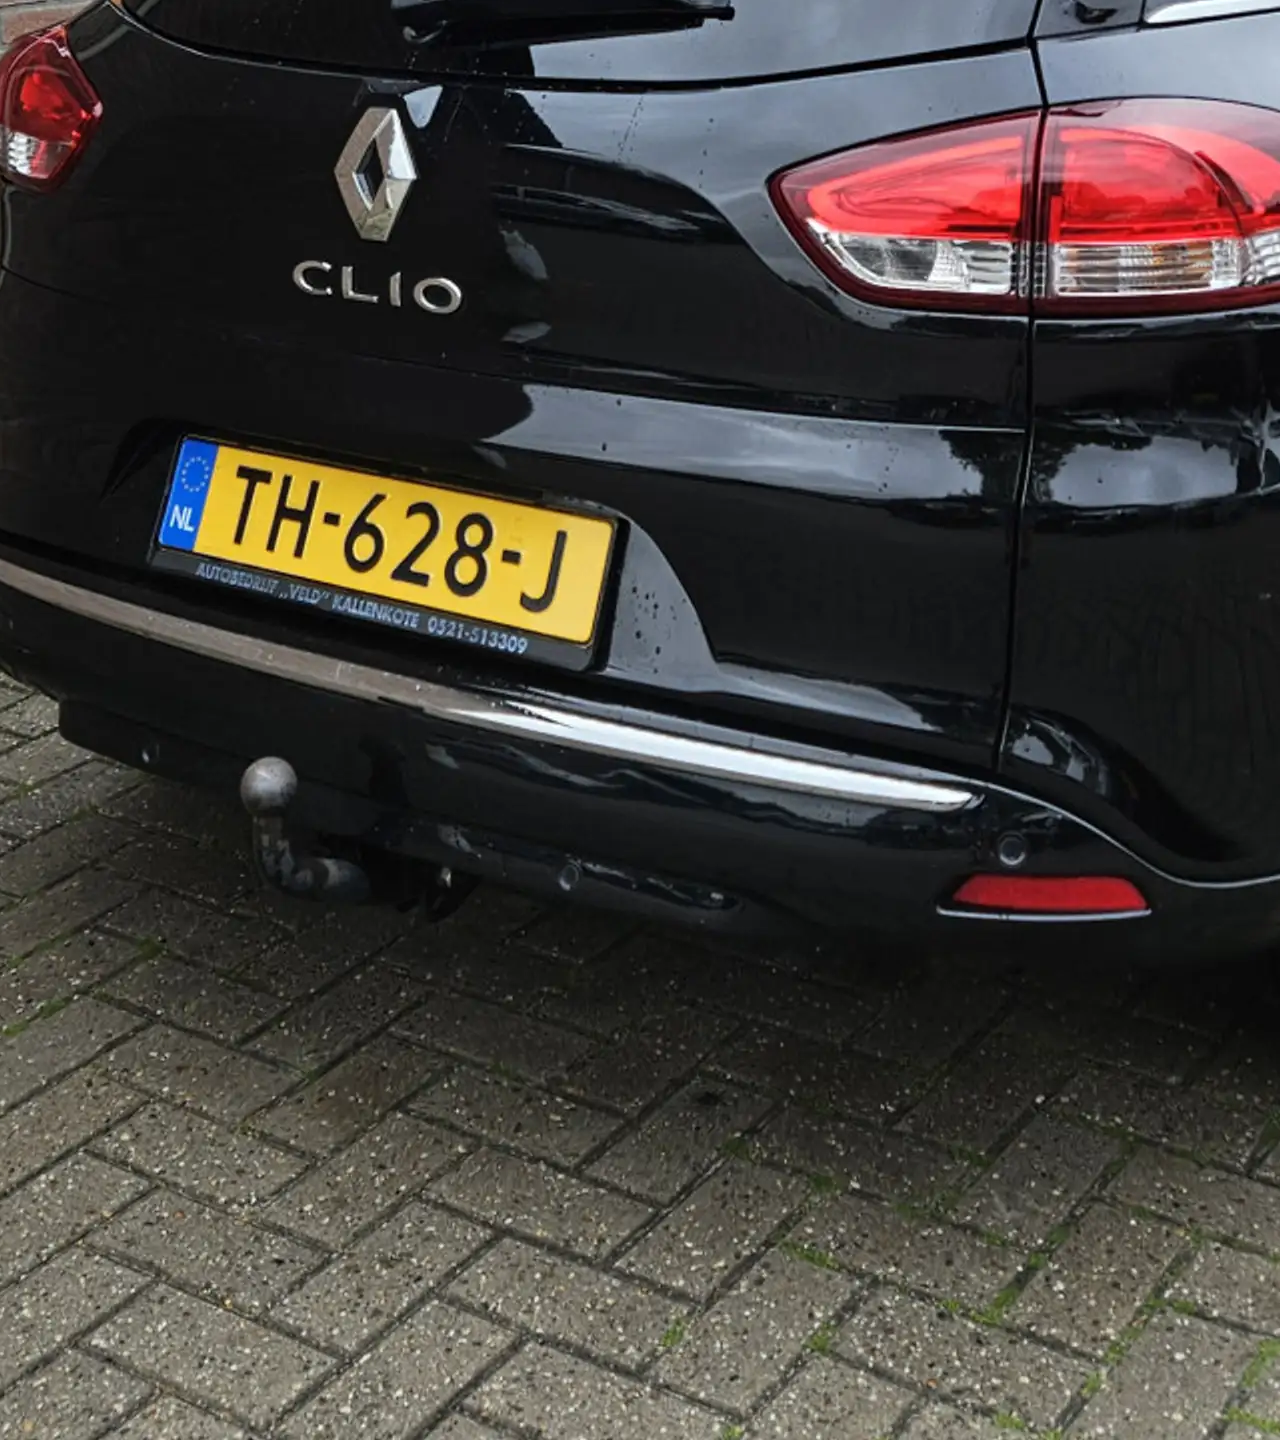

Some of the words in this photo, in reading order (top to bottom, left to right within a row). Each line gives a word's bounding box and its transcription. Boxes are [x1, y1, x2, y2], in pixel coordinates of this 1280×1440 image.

[292, 260, 462, 313] CLIO
[169, 504, 194, 532] NL
[234, 465, 567, 612] TH-628-J
[332, 594, 419, 628] KALLENKOTE
[428, 616, 528, 654] 0521-513309
